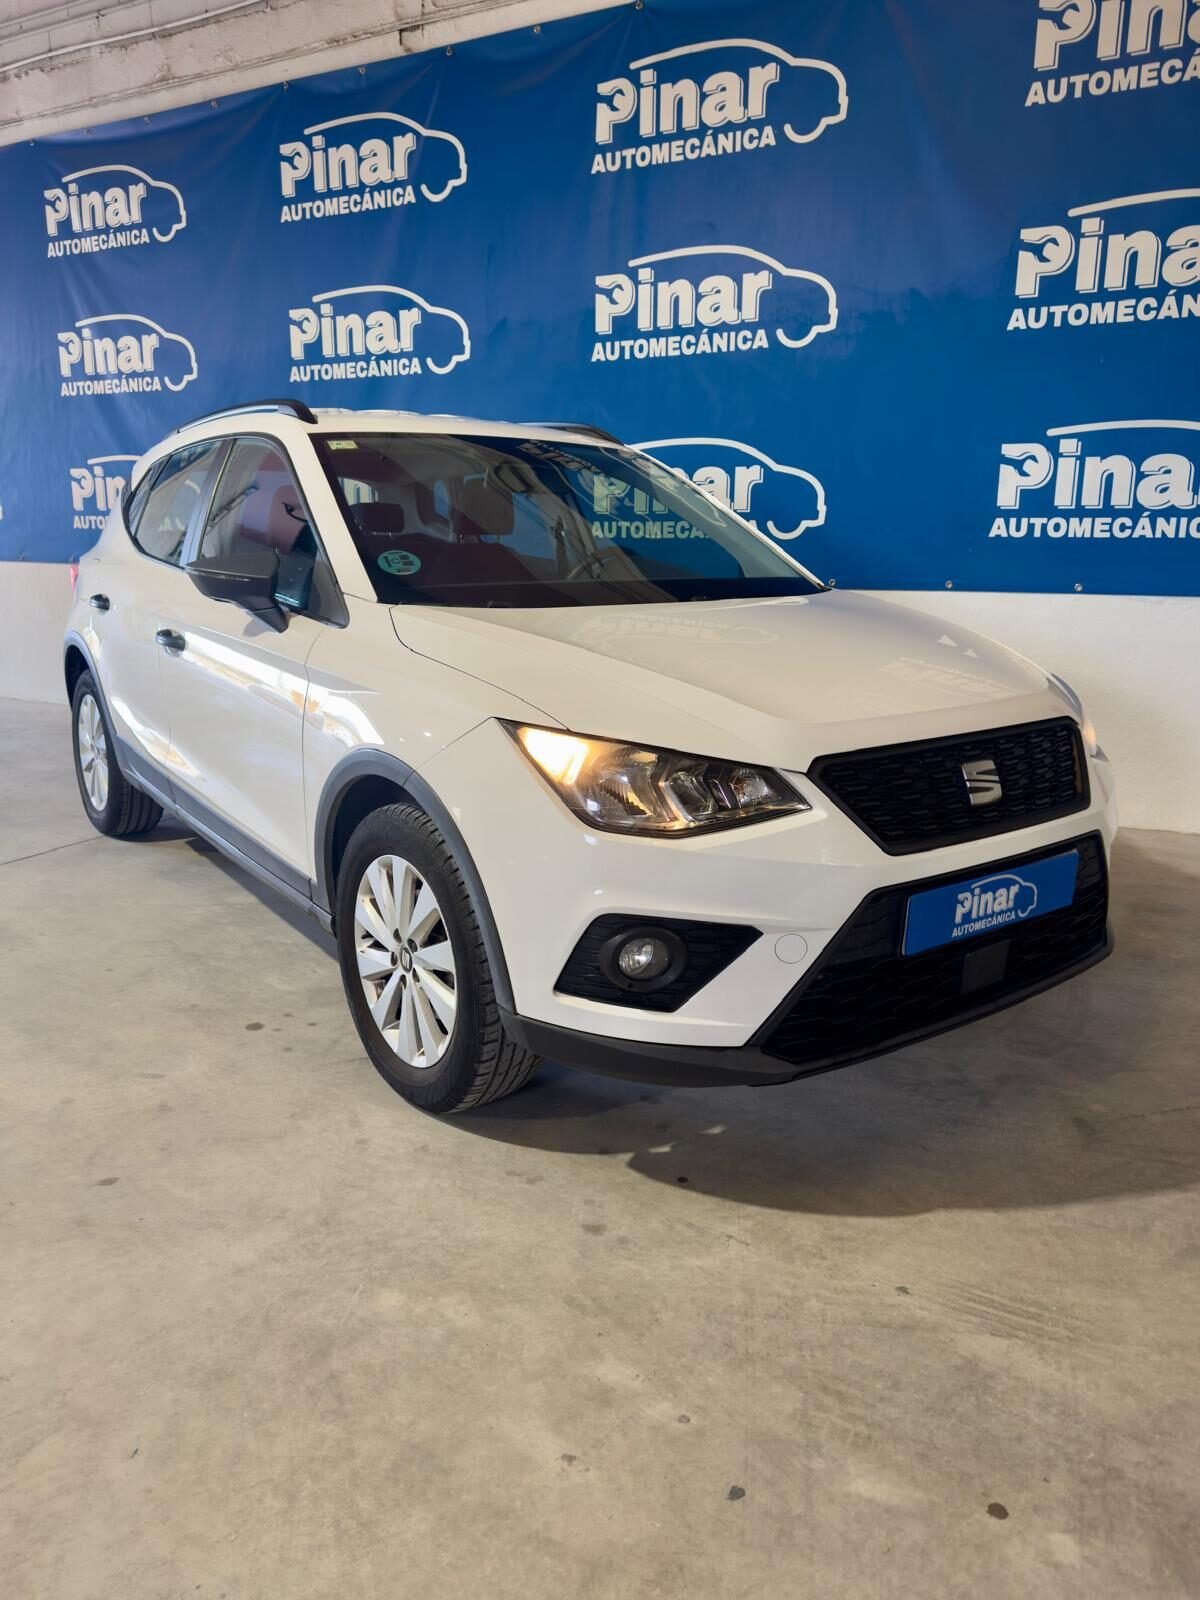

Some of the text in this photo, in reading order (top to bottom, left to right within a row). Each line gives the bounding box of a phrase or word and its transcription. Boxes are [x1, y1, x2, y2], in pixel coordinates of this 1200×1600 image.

[595, 62, 780, 145] Pinar
[279, 131, 417, 198] Pinar
[591, 126, 776, 174] AUTOMECÁNICA
[44, 182, 148, 237] Pinar
[280, 187, 417, 223] AUTOMECÁNICA
[47, 228, 150, 258] AUTOMECÁNICA
[595, 267, 773, 335] Pinar
[57, 329, 160, 378] Pinar
[289, 304, 422, 361] Pinar
[591, 329, 769, 362] AUTOMECÁNICA
[60, 376, 162, 397] AUTOMECÁNICA
[289, 357, 422, 383] AUTOMECÁNICA
[69, 465, 126, 511] Pin
[996, 438, 1200, 509] Pina
[73, 515, 109, 530] AUTO
[952, 910, 1015, 937] AUTOMECÁNICA
[954, 884, 1019, 923] Pinar
